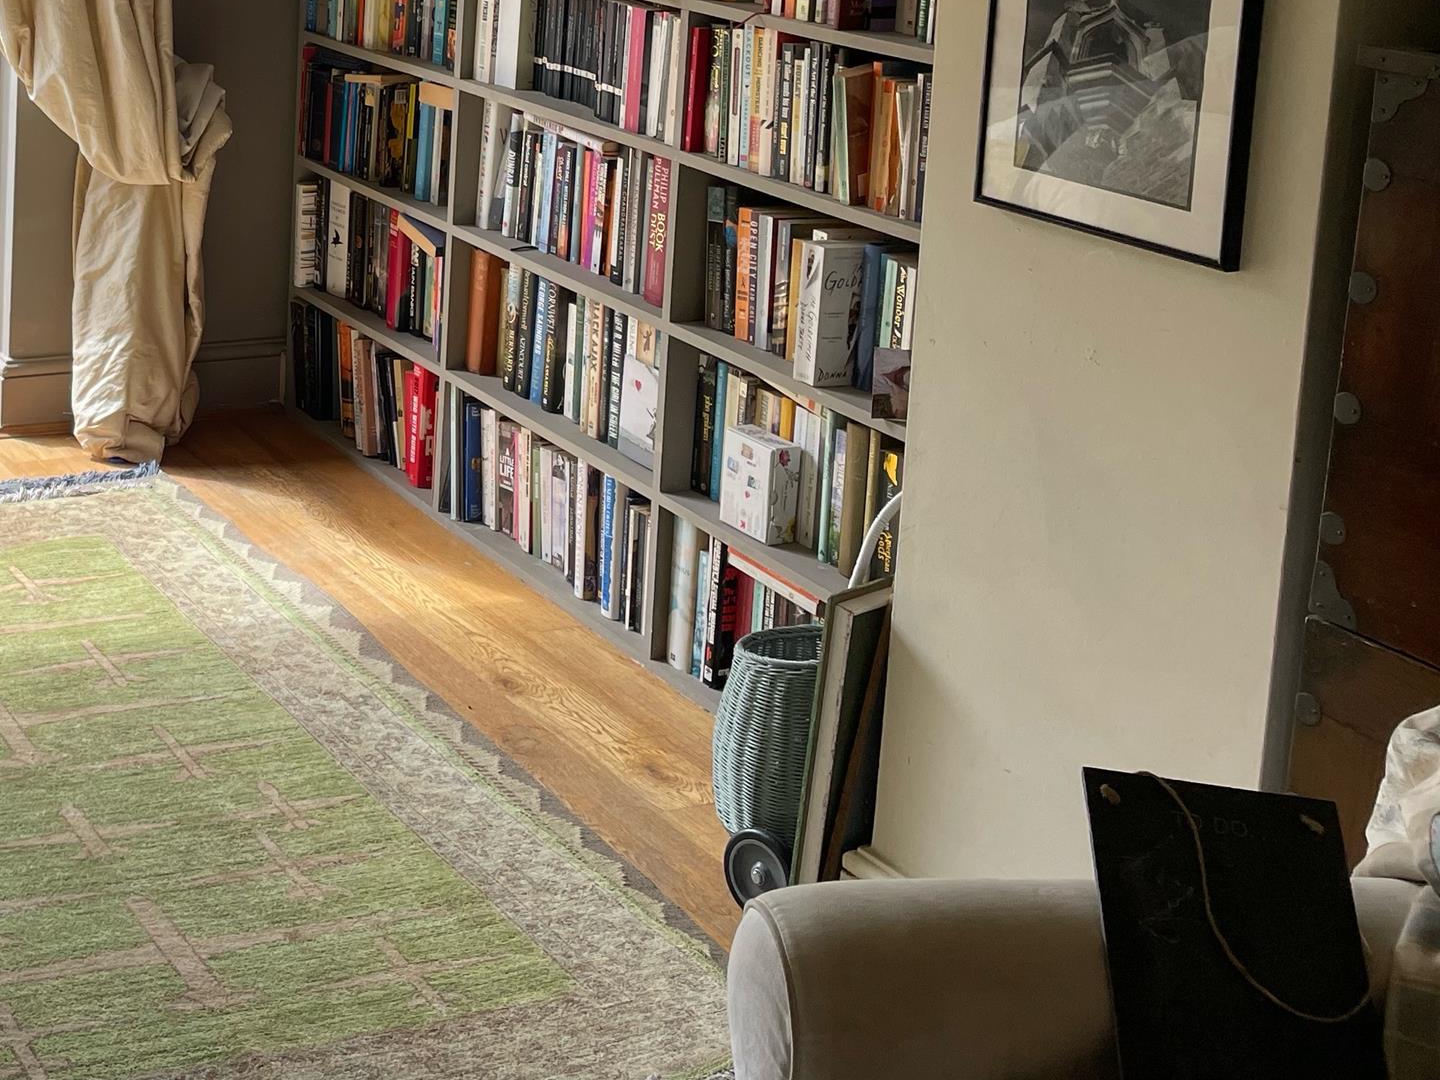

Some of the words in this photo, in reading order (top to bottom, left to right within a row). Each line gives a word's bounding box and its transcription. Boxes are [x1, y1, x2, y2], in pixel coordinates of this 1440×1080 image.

[745, 26, 753, 76] BLACKOUT
[506, 150, 516, 186] DUNBAR
[652, 157, 661, 209] PULLMAN
[660, 167, 669, 203] PHILIP
[649, 213, 657, 248] DUST
[655, 213, 666, 253] BOOK
[547, 283, 557, 334] CORNWELL
[895, 284, 905, 328] Wonder
[507, 329, 515, 372] BERNARD
[535, 313, 544, 355] SAUNDERS
[518, 335, 526, 381] AZINCOURT
[591, 340, 599, 373] AJAX
[612, 341, 621, 367] MILLER
[611, 386, 620, 403] GIRL
[612, 372, 620, 386] THE
[610, 403, 618, 414] IN
[704, 394, 713, 412] john
[609, 414, 618, 438] GREEN
[703, 413, 711, 441] grisham
[877, 534, 885, 561] Gods
[884, 532, 893, 573] American
